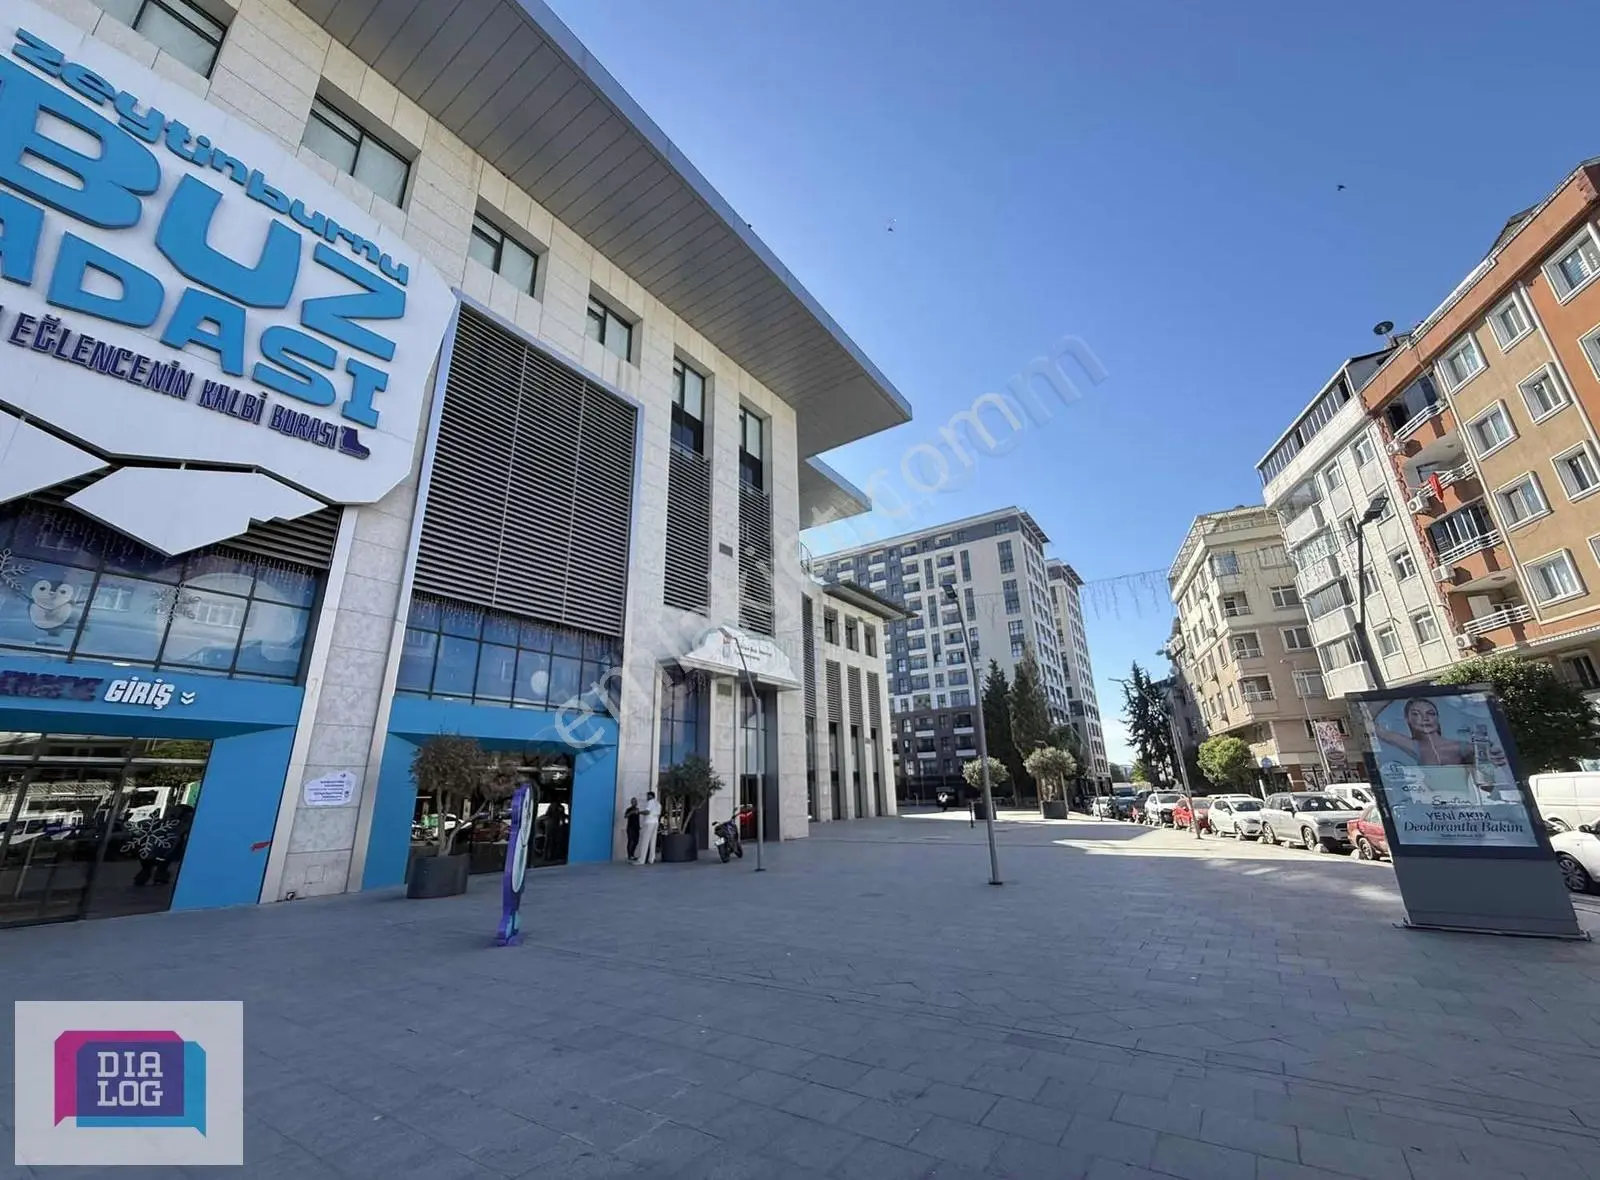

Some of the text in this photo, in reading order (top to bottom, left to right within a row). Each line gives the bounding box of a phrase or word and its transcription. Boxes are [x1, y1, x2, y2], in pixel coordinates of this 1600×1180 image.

[0, 54, 407, 362] BUZ
[8, 311, 339, 450] EĞLENCENİN KALBİ BURASI
[104, 676, 176, 710] GİRİŞ
[1404, 821, 1478, 834] Deodorantla
